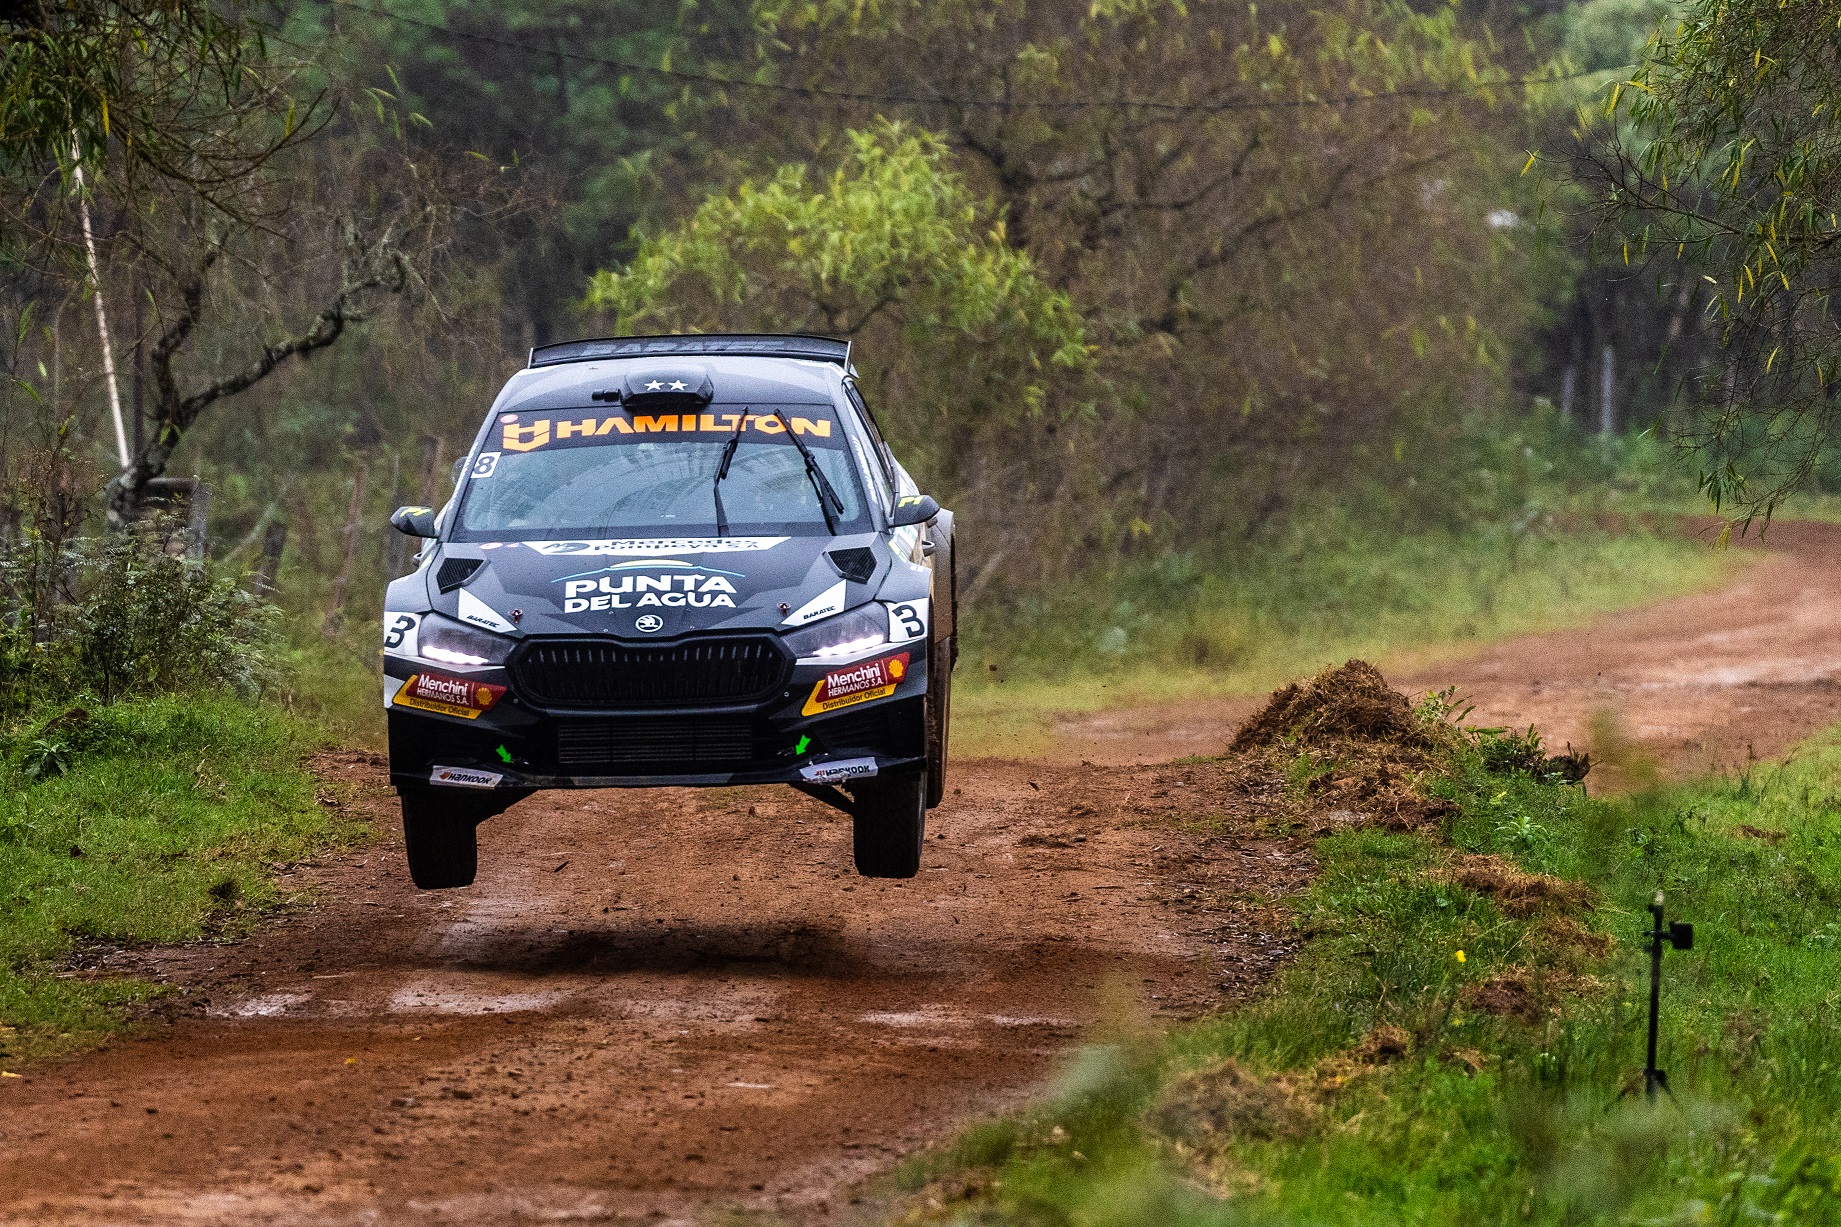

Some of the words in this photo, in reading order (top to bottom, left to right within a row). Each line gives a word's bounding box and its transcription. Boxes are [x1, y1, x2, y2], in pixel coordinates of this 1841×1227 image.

[556, 414, 831, 438] HAMILTON
[474, 455, 496, 474] 8
[565, 574, 737, 599] PUNTA
[564, 594, 632, 614] DEL
[636, 591, 737, 608] AGUA
[803, 605, 836, 620] BARATEC
[384, 614, 417, 649] 3
[891, 604, 926, 638] 3
[417, 674, 469, 696] Menchini
[827, 662, 881, 689] Menchini
[416, 687, 455, 703] HERMANOS
[822, 694, 863, 711] Distribuidor
[864, 688, 886, 699] Oficial
[828, 680, 870, 697] HERMANOS
